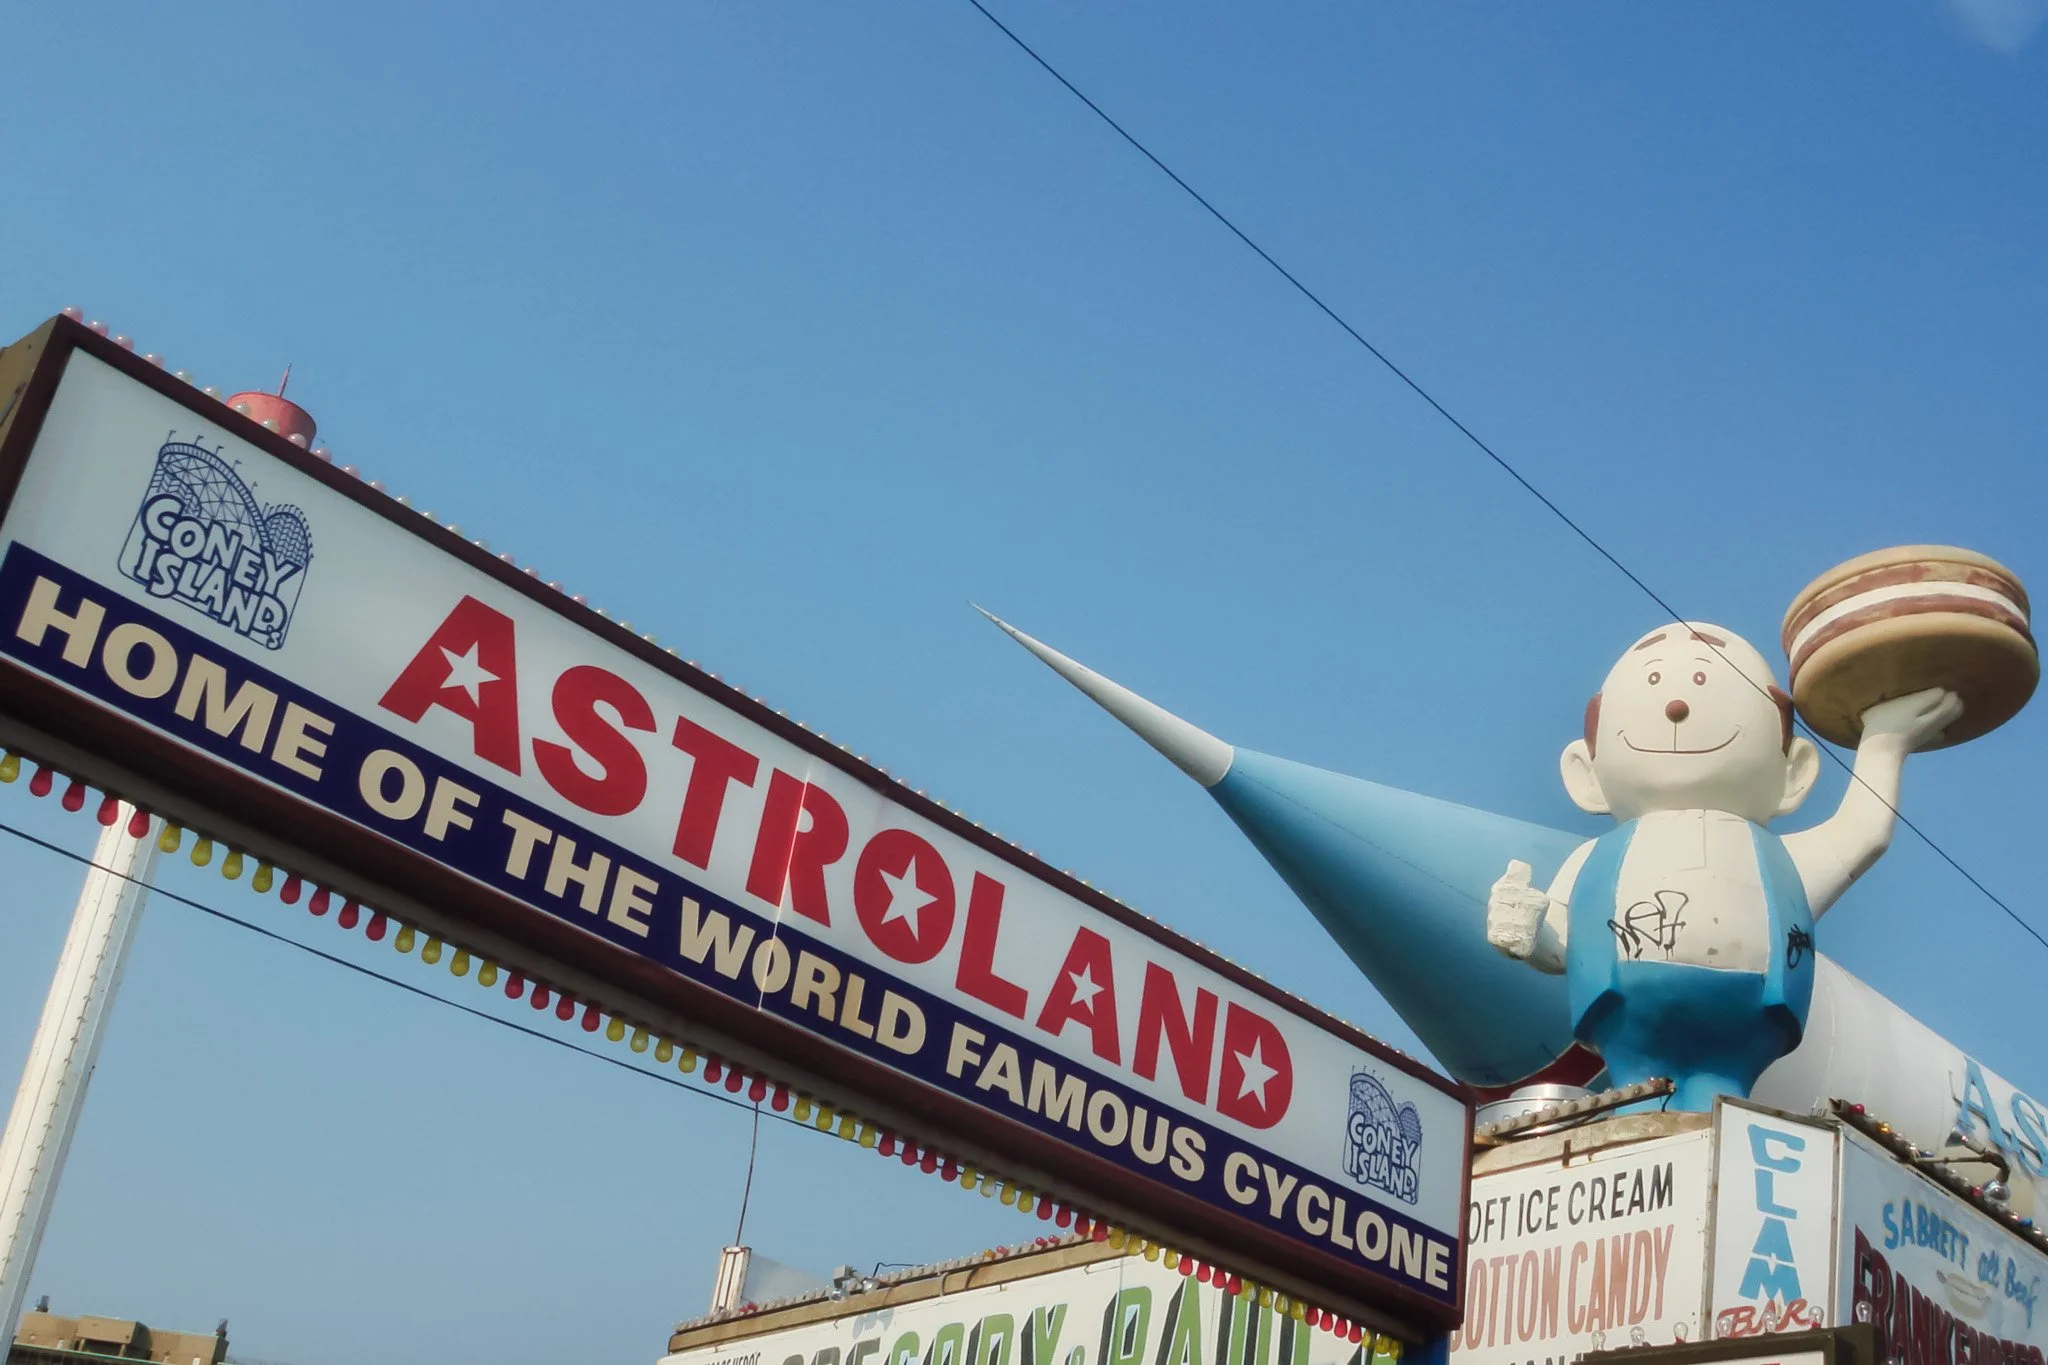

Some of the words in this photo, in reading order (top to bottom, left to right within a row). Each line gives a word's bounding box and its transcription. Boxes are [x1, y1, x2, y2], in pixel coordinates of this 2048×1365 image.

[141, 494, 303, 598] CONEY
[377, 594, 1293, 1130] ASTROLAND
[15, 576, 335, 782] HOME
[358, 749, 481, 841] OF
[502, 809, 659, 938] THE
[680, 896, 926, 1055] WORLD
[946, 1022, 1206, 1182] FAMOUS
[1223, 1152, 1450, 1291] CYCLONE
[1349, 1111, 1420, 1169] CONEY
[1517, 1185, 1561, 1237] ICE
[1568, 1162, 1673, 1225] CREAM
[1738, 1124, 1805, 1306] CLAM
[1881, 1199, 1970, 1271] SABRETT
[1450, 1246, 1562, 1353] OTTON
[1567, 1224, 1674, 1335] CANDY
[1717, 1298, 1815, 1338] BAR
